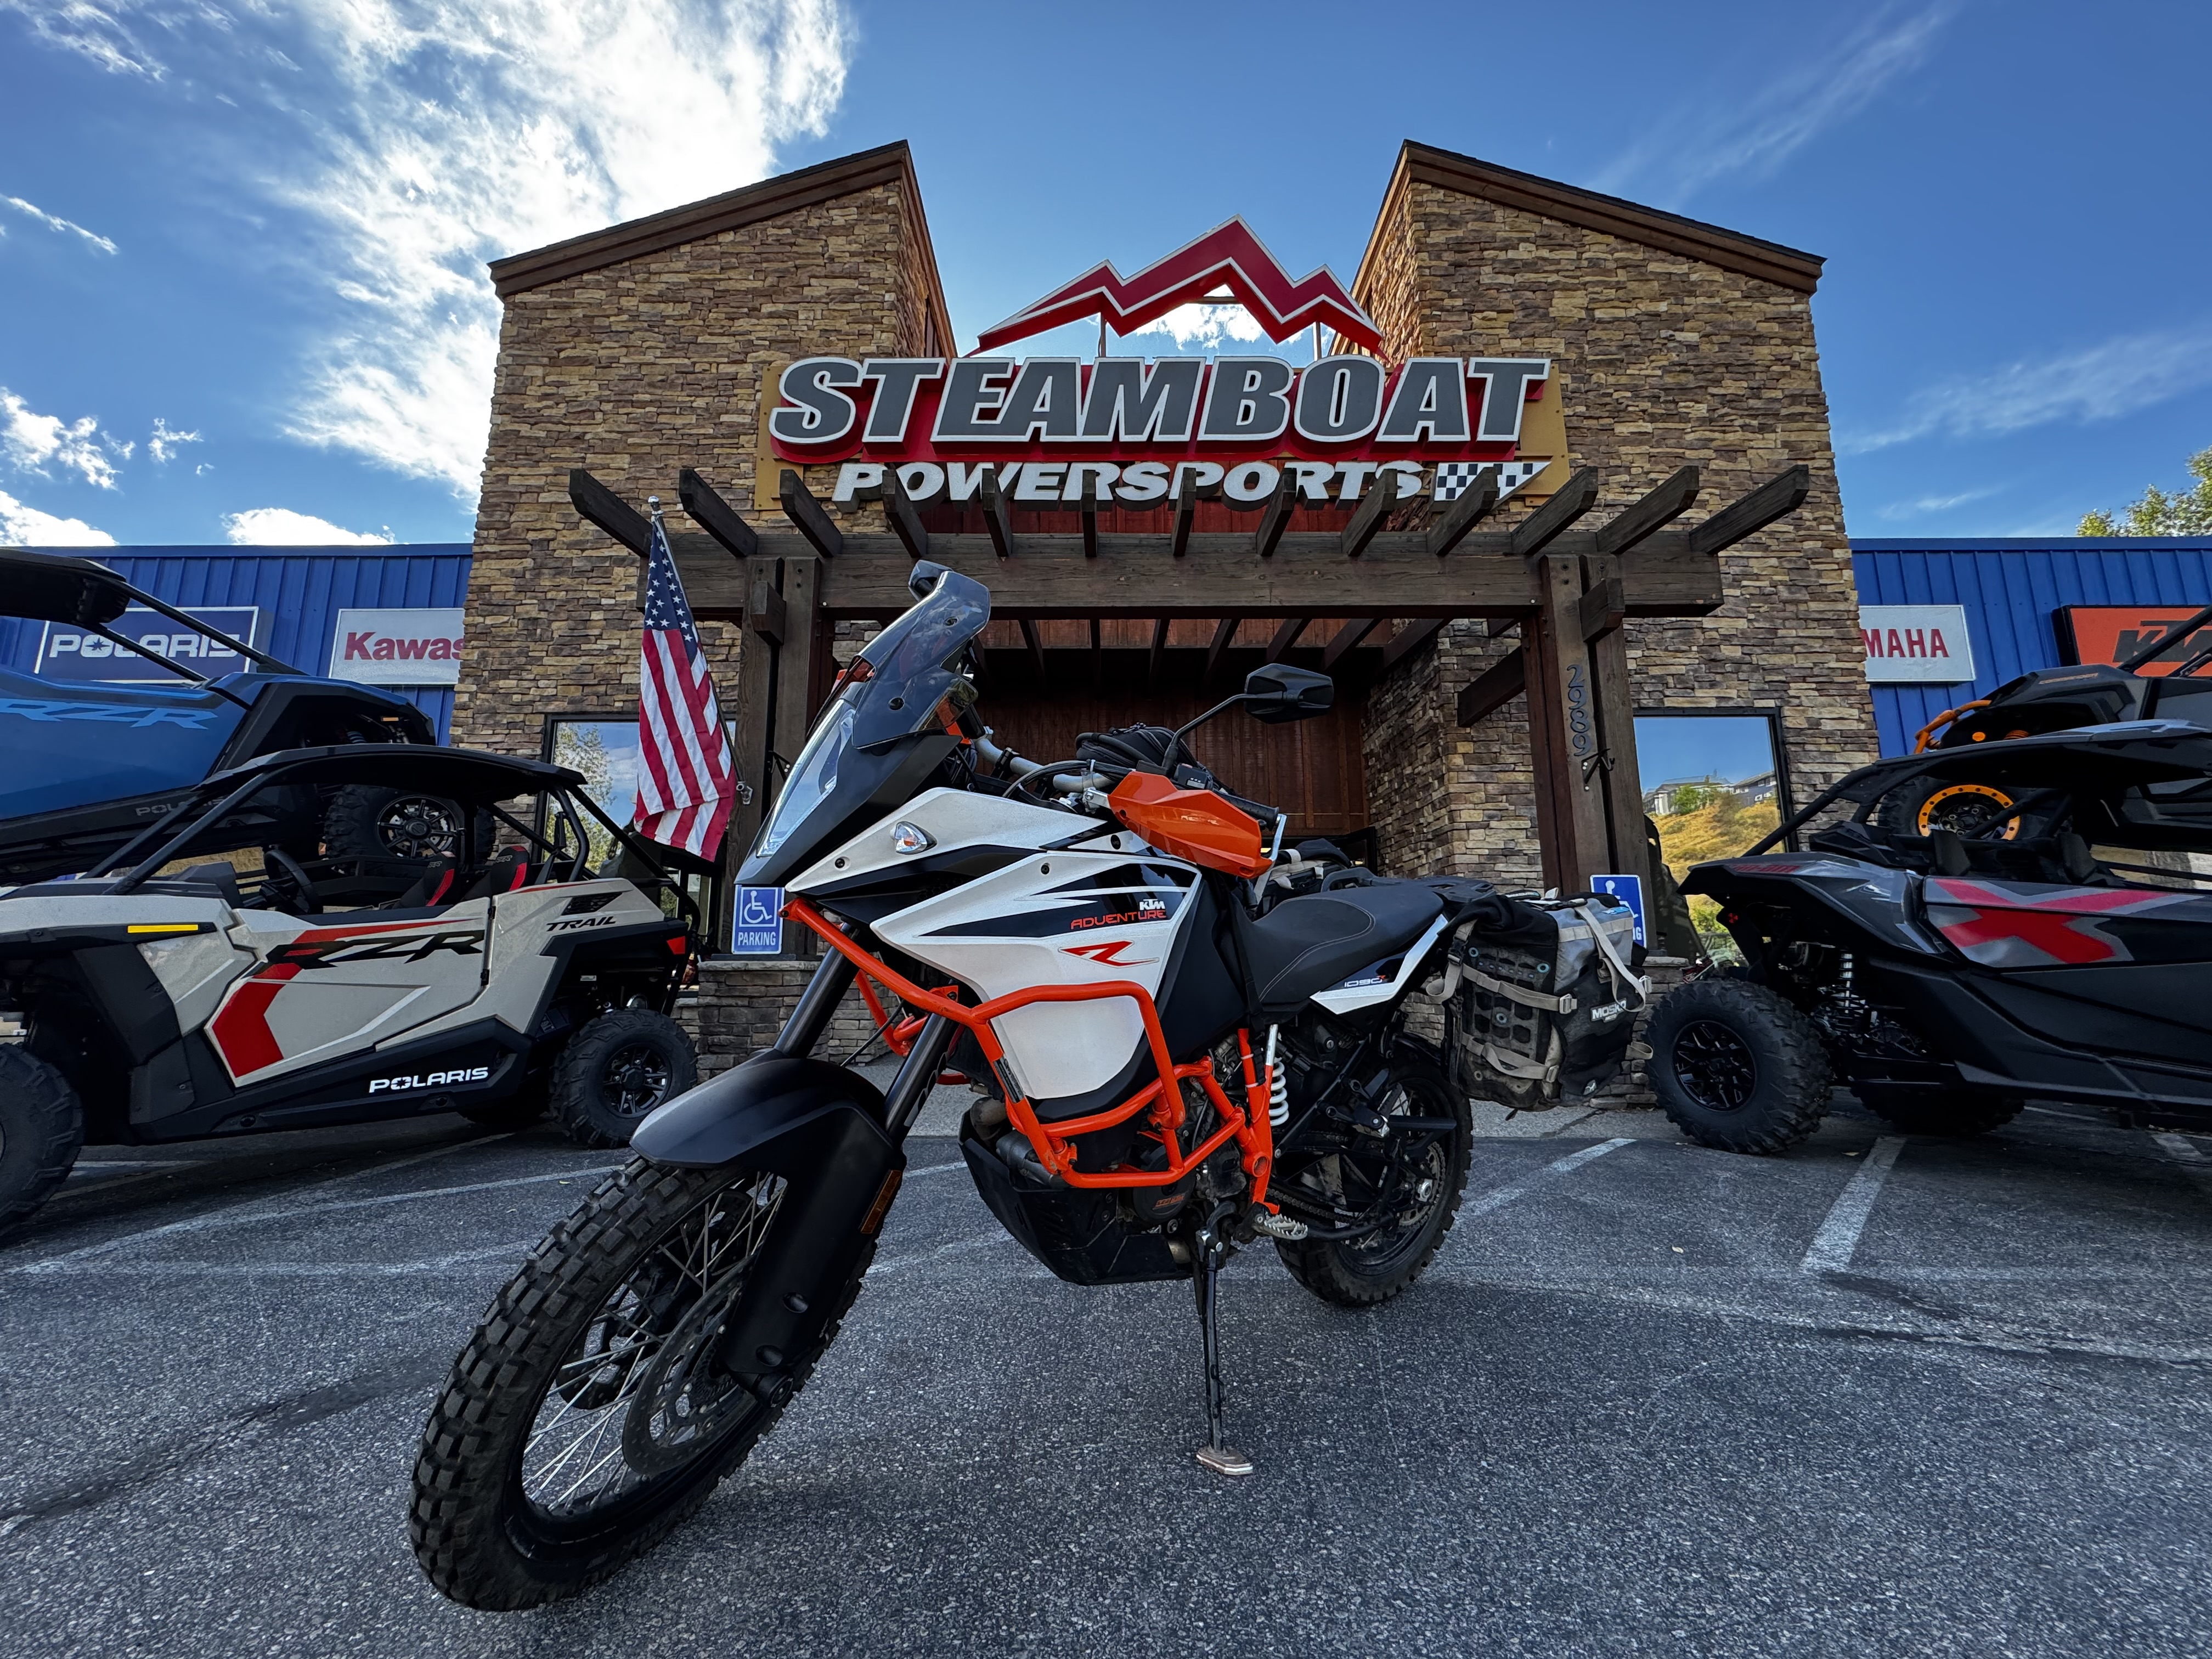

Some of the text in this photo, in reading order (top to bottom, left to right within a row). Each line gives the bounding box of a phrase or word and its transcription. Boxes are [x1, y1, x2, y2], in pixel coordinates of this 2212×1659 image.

[769, 354, 1551, 444] STEAMBOAT
[831, 461, 1424, 501] POWERSPORTS
[49, 634, 240, 658] POLARIS
[0, 698, 218, 730] RZR
[1566, 664, 1592, 757] 2989
[1139, 899, 1166, 911] KTM
[546, 916, 617, 932] TRAIL
[1071, 910, 1167, 930] ADVENTURE
[737, 932, 776, 946] PARKING
[241, 929, 486, 979] RZR
[1344, 978, 1383, 988] 1090
[369, 1066, 489, 1093] POLARIS
